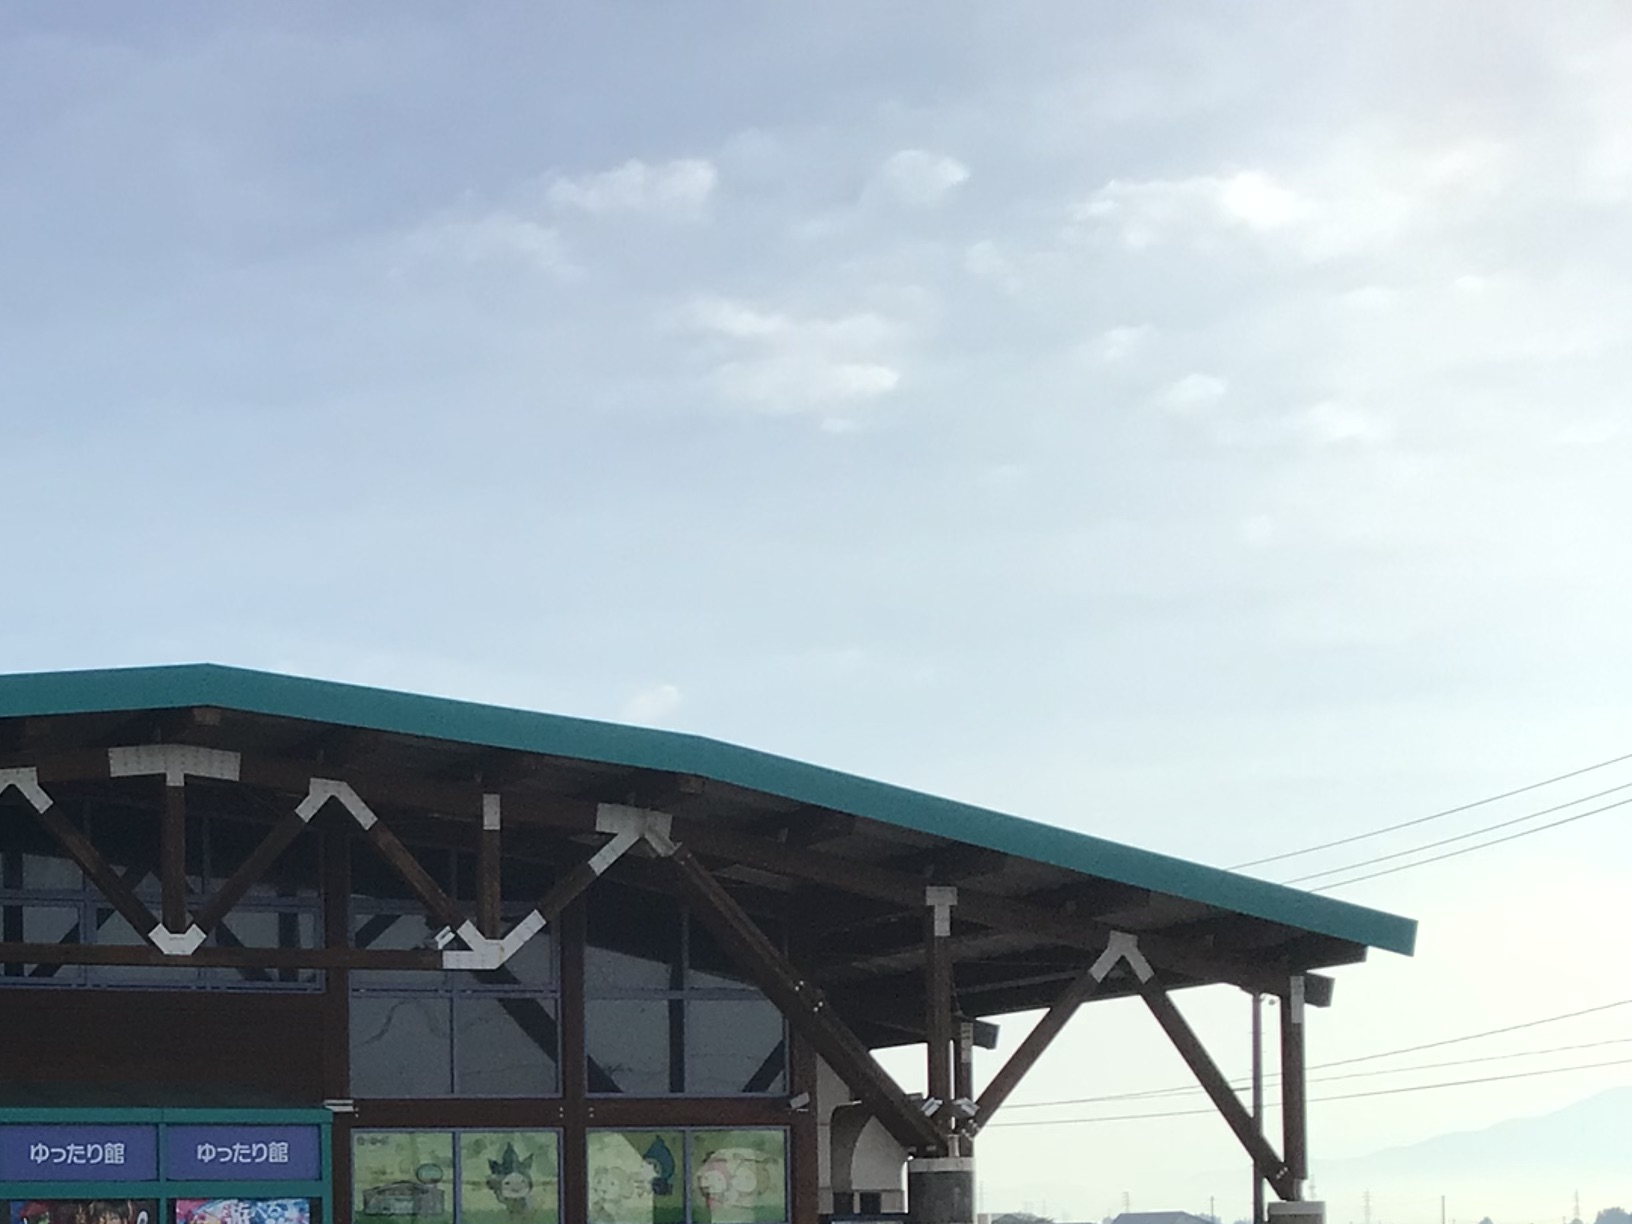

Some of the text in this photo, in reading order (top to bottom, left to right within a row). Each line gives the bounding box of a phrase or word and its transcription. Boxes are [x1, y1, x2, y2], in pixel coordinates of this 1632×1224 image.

[30, 1142, 125, 1164] ゆったり館
[196, 1141, 289, 1163] ゆったり館
